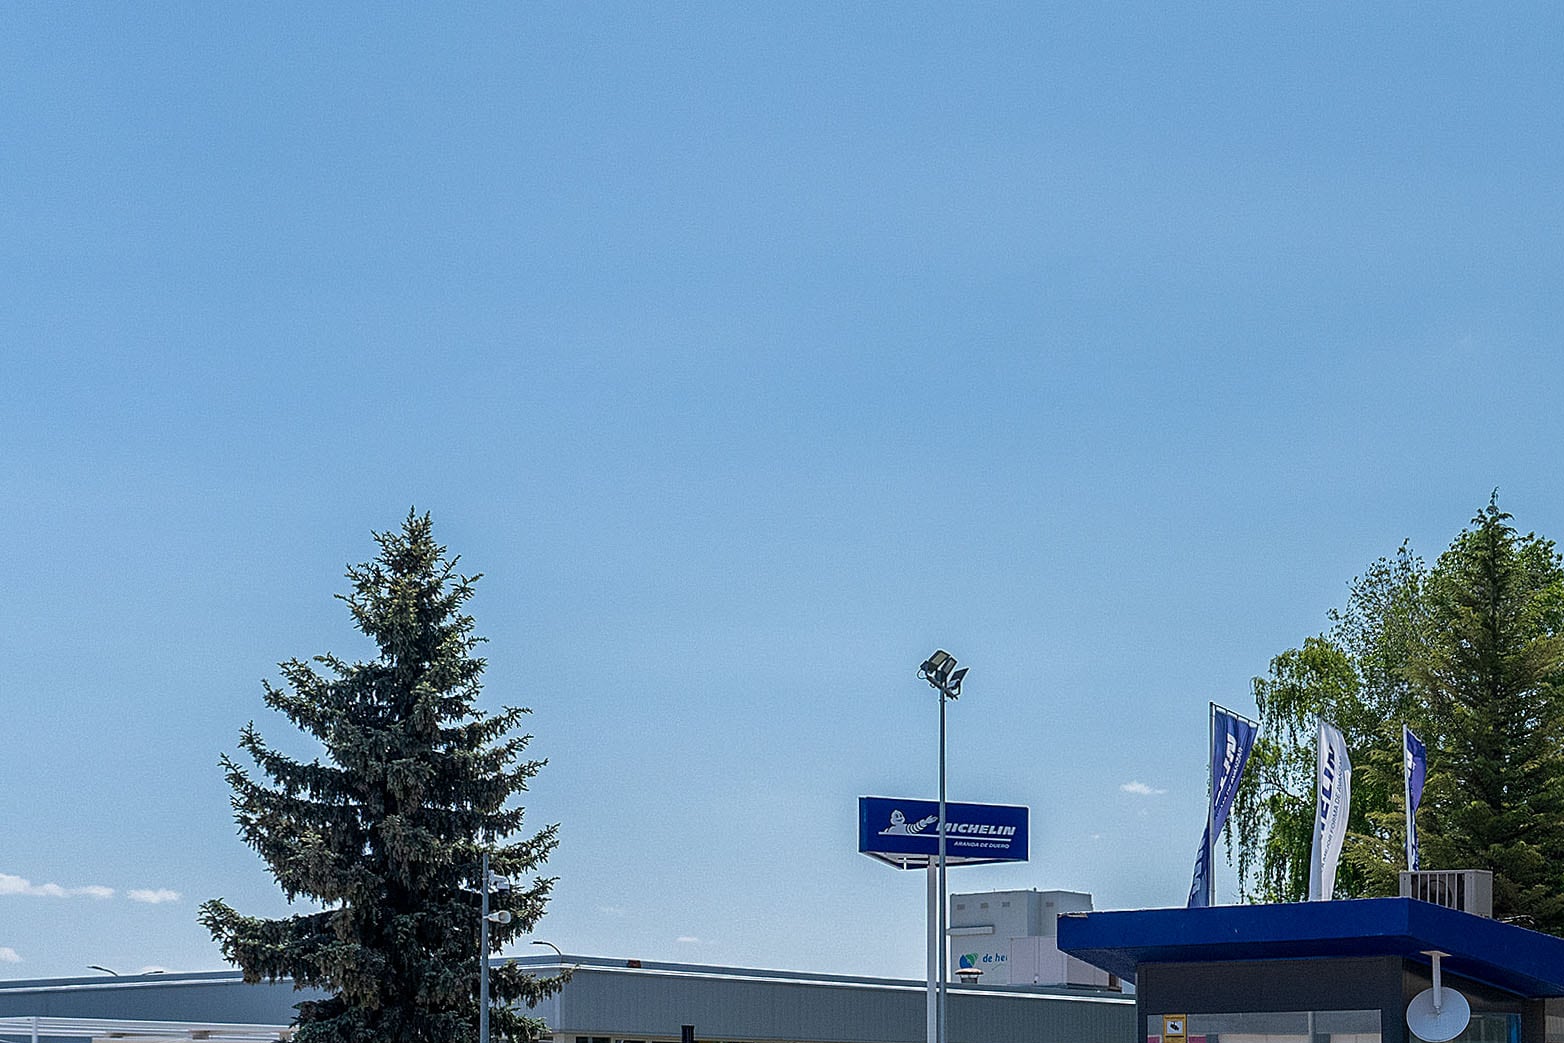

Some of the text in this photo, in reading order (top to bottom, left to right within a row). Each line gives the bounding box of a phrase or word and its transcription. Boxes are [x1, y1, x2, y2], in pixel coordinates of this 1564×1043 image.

[1329, 806, 1339, 834] FORMA
[936, 822, 1016, 836] MICHELIN
[982, 953, 993, 963] de
